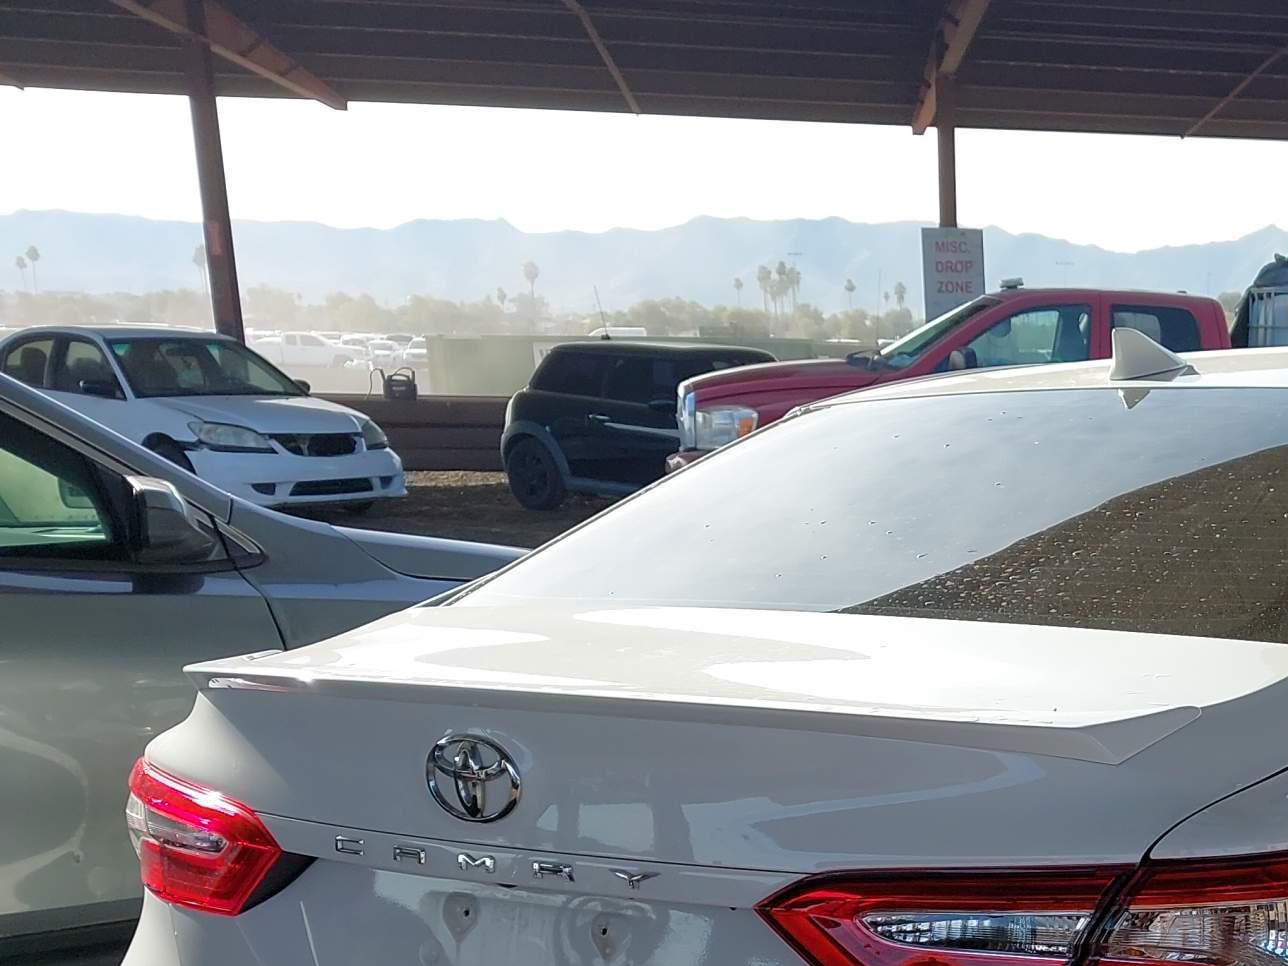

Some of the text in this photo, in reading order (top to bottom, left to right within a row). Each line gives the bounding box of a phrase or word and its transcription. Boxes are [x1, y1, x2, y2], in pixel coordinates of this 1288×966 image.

[935, 240, 972, 254] MISC.
[935, 260, 974, 274] DROP
[936, 280, 974, 295] ZONE
[335, 834, 661, 889] CAMRY
